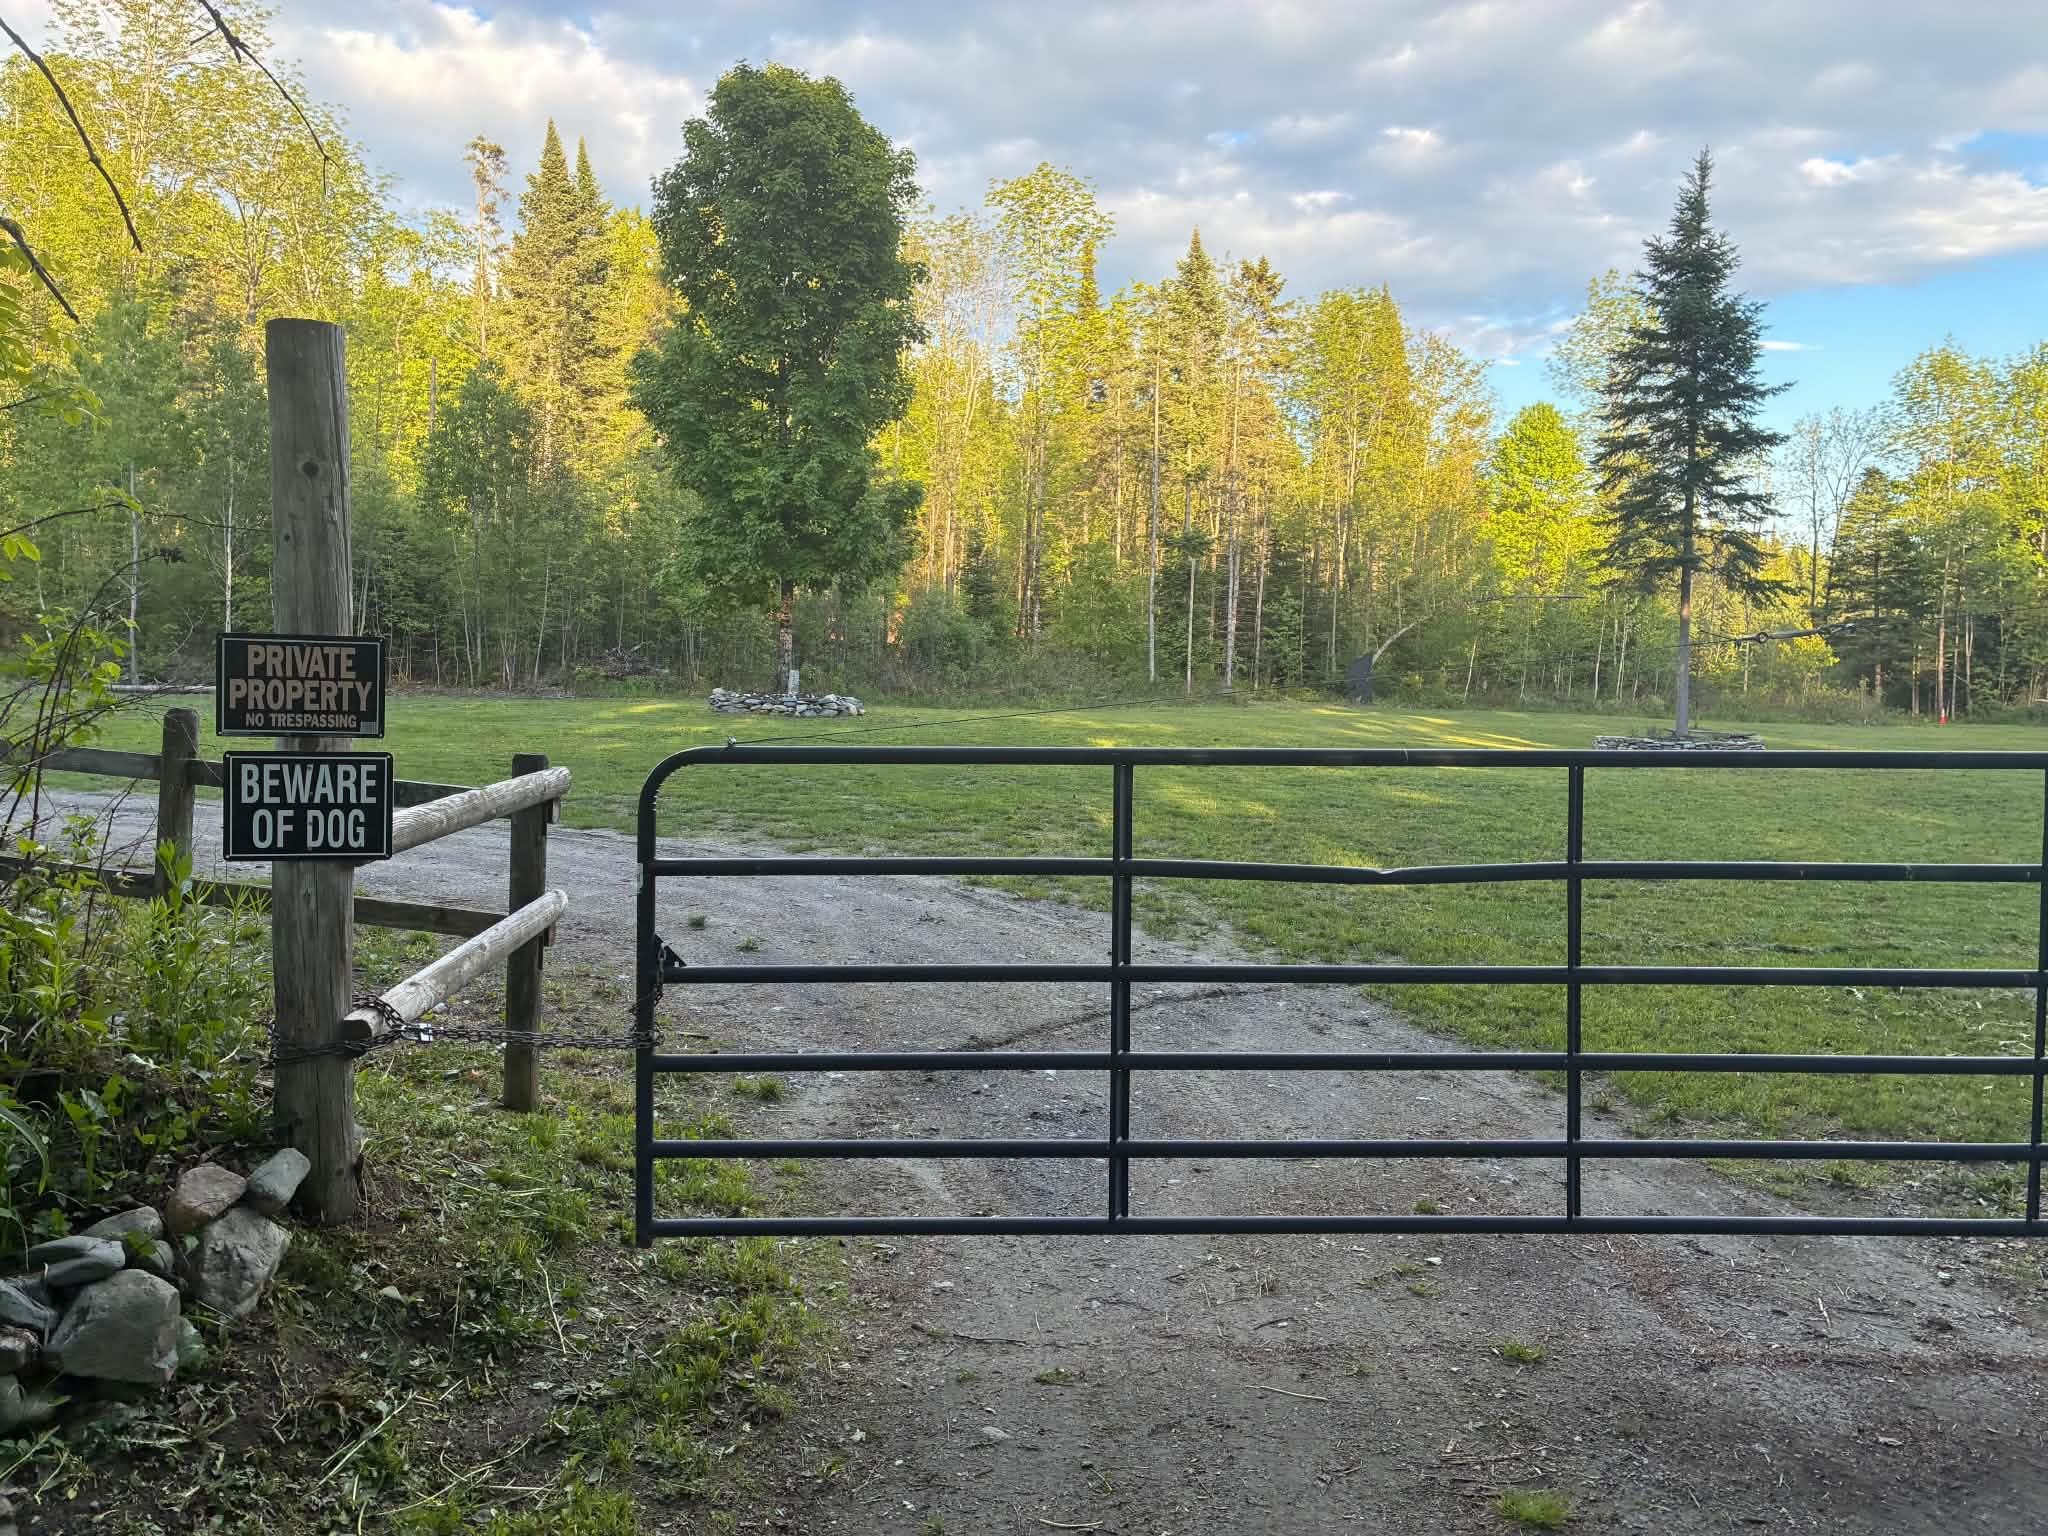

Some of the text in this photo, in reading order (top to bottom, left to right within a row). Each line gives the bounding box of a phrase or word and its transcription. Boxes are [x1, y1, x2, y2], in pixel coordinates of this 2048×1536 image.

[247, 644, 356, 679] PRIVATE
[229, 678, 372, 712] PROPERTY
[245, 712, 357, 729] NO TRESPASSING
[240, 763, 377, 804] BEWARE
[252, 808, 365, 849] OF DOG
